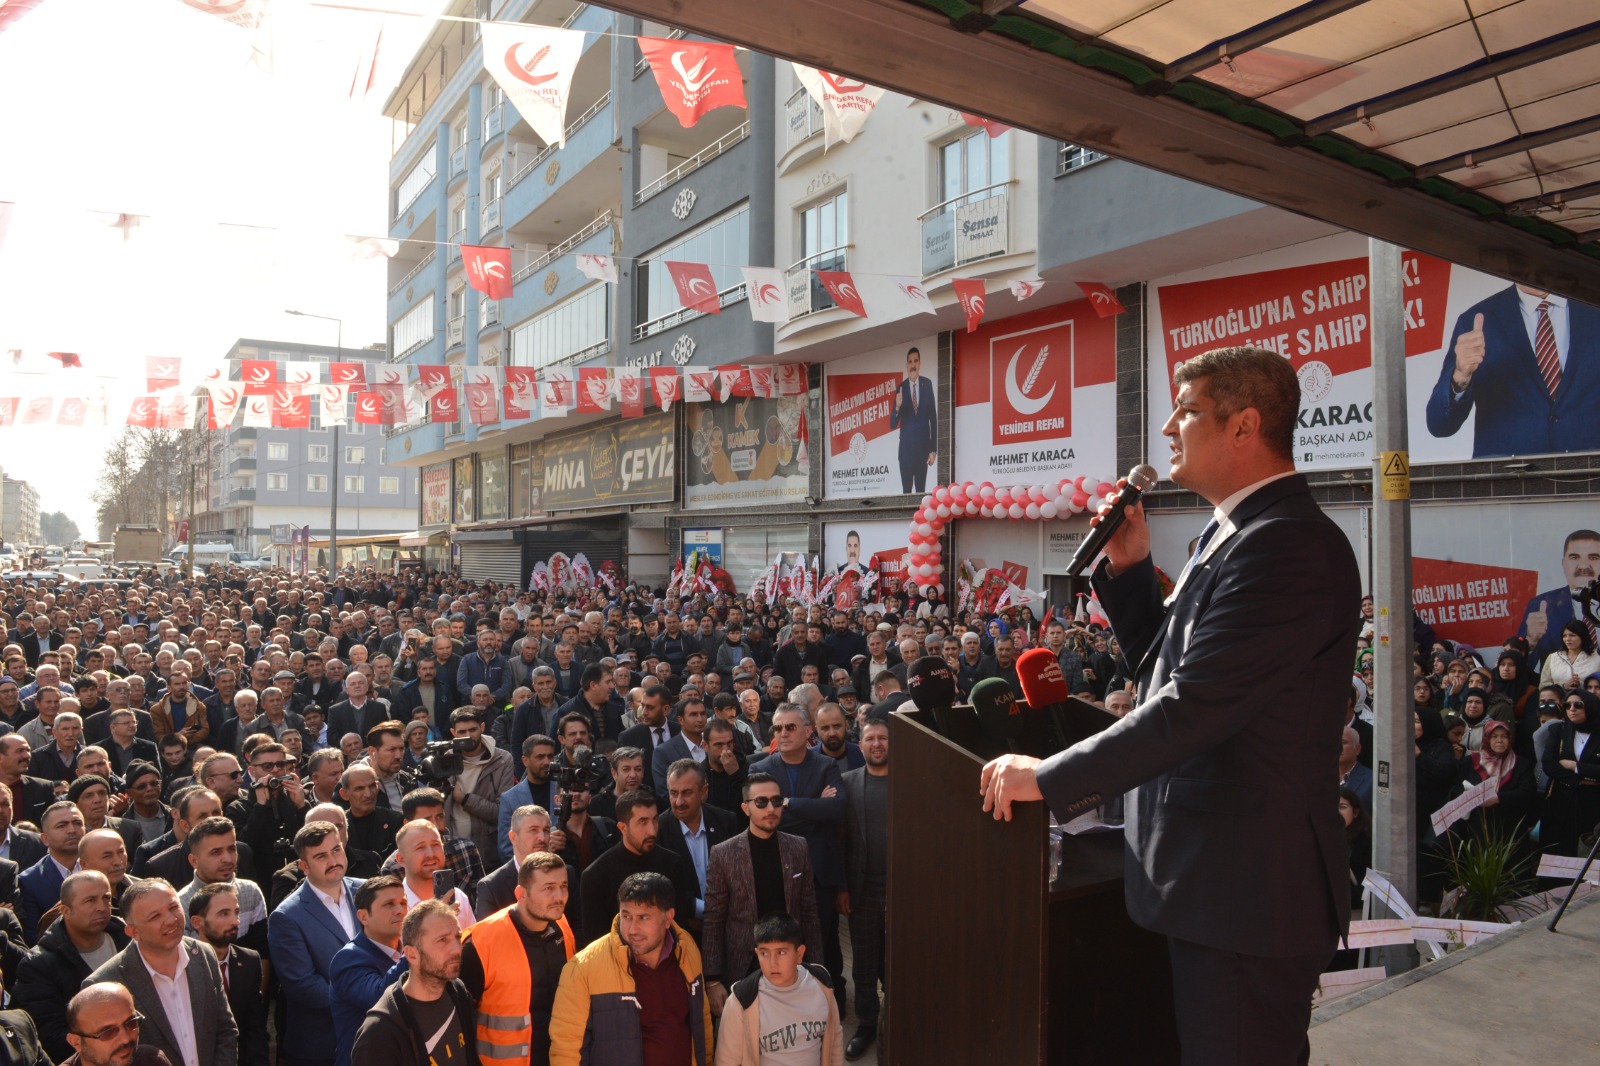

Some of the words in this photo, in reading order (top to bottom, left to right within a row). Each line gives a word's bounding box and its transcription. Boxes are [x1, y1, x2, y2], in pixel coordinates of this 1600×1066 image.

[962, 215, 999, 237] Şensa
[1169, 295, 1296, 352] TÜRKOĞLU'NA
[1301, 273, 1367, 315] SAHİP
[1401, 258, 1421, 288] K!
[1296, 313, 1367, 356] SAHİP
[1403, 298, 1426, 332] K!
[831, 412, 862, 438] YENİDEN
[863, 400, 889, 425] REFAH
[999, 419, 1034, 436] YENİDEN
[1036, 416, 1065, 431] REFAH
[1300, 432, 1345, 448] BAŞKAN
[989, 452, 1029, 467] MEHMET
[1031, 448, 1076, 463] KARACA
[1315, 450, 1365, 460] mehmetkaraca
[543, 456, 586, 493] MİNA
[832, 467, 859, 479] MEHMET
[860, 465, 890, 478] KARACA
[992, 466, 1016, 475] TÜRKOĞLU
[1016, 465, 1037, 473] BELEDİYE
[1037, 464, 1057, 473] BAŞKAN
[741, 488, 758, 499] SANAT
[1050, 531, 1079, 541] MEHMET
[1467, 577, 1508, 599] REFAH
[1438, 605, 1457, 624] İLE
[1459, 599, 1510, 622] GELECEK
[759, 1023, 797, 1055] NEW
